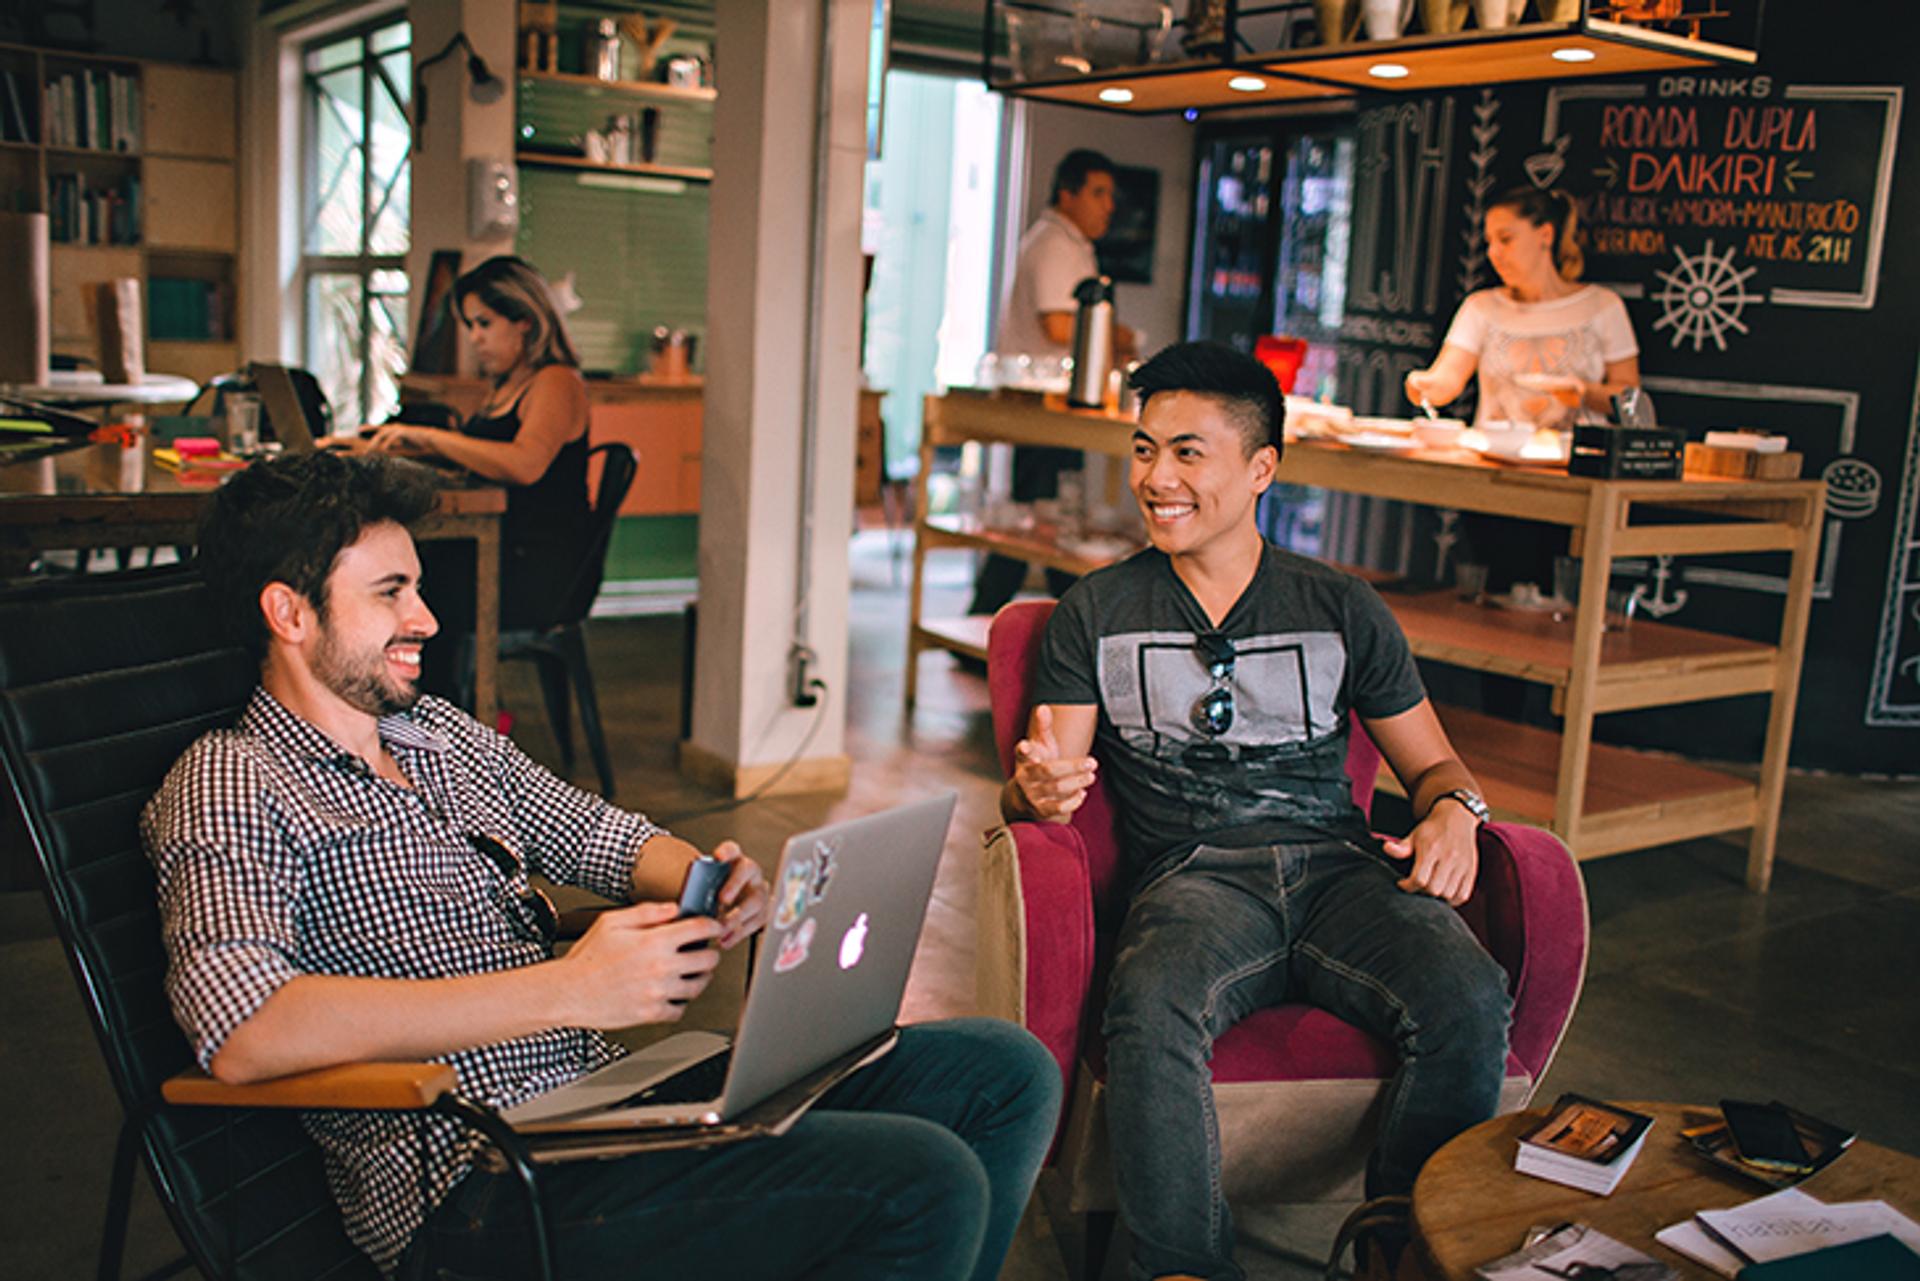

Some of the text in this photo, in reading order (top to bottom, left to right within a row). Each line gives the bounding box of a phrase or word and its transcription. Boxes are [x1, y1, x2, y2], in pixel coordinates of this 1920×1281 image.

[1658, 76, 1773, 98] DRINKS
[1600, 104, 1817, 152] RODADA DUPLA
[1627, 153, 1776, 196] DAIKIRI
